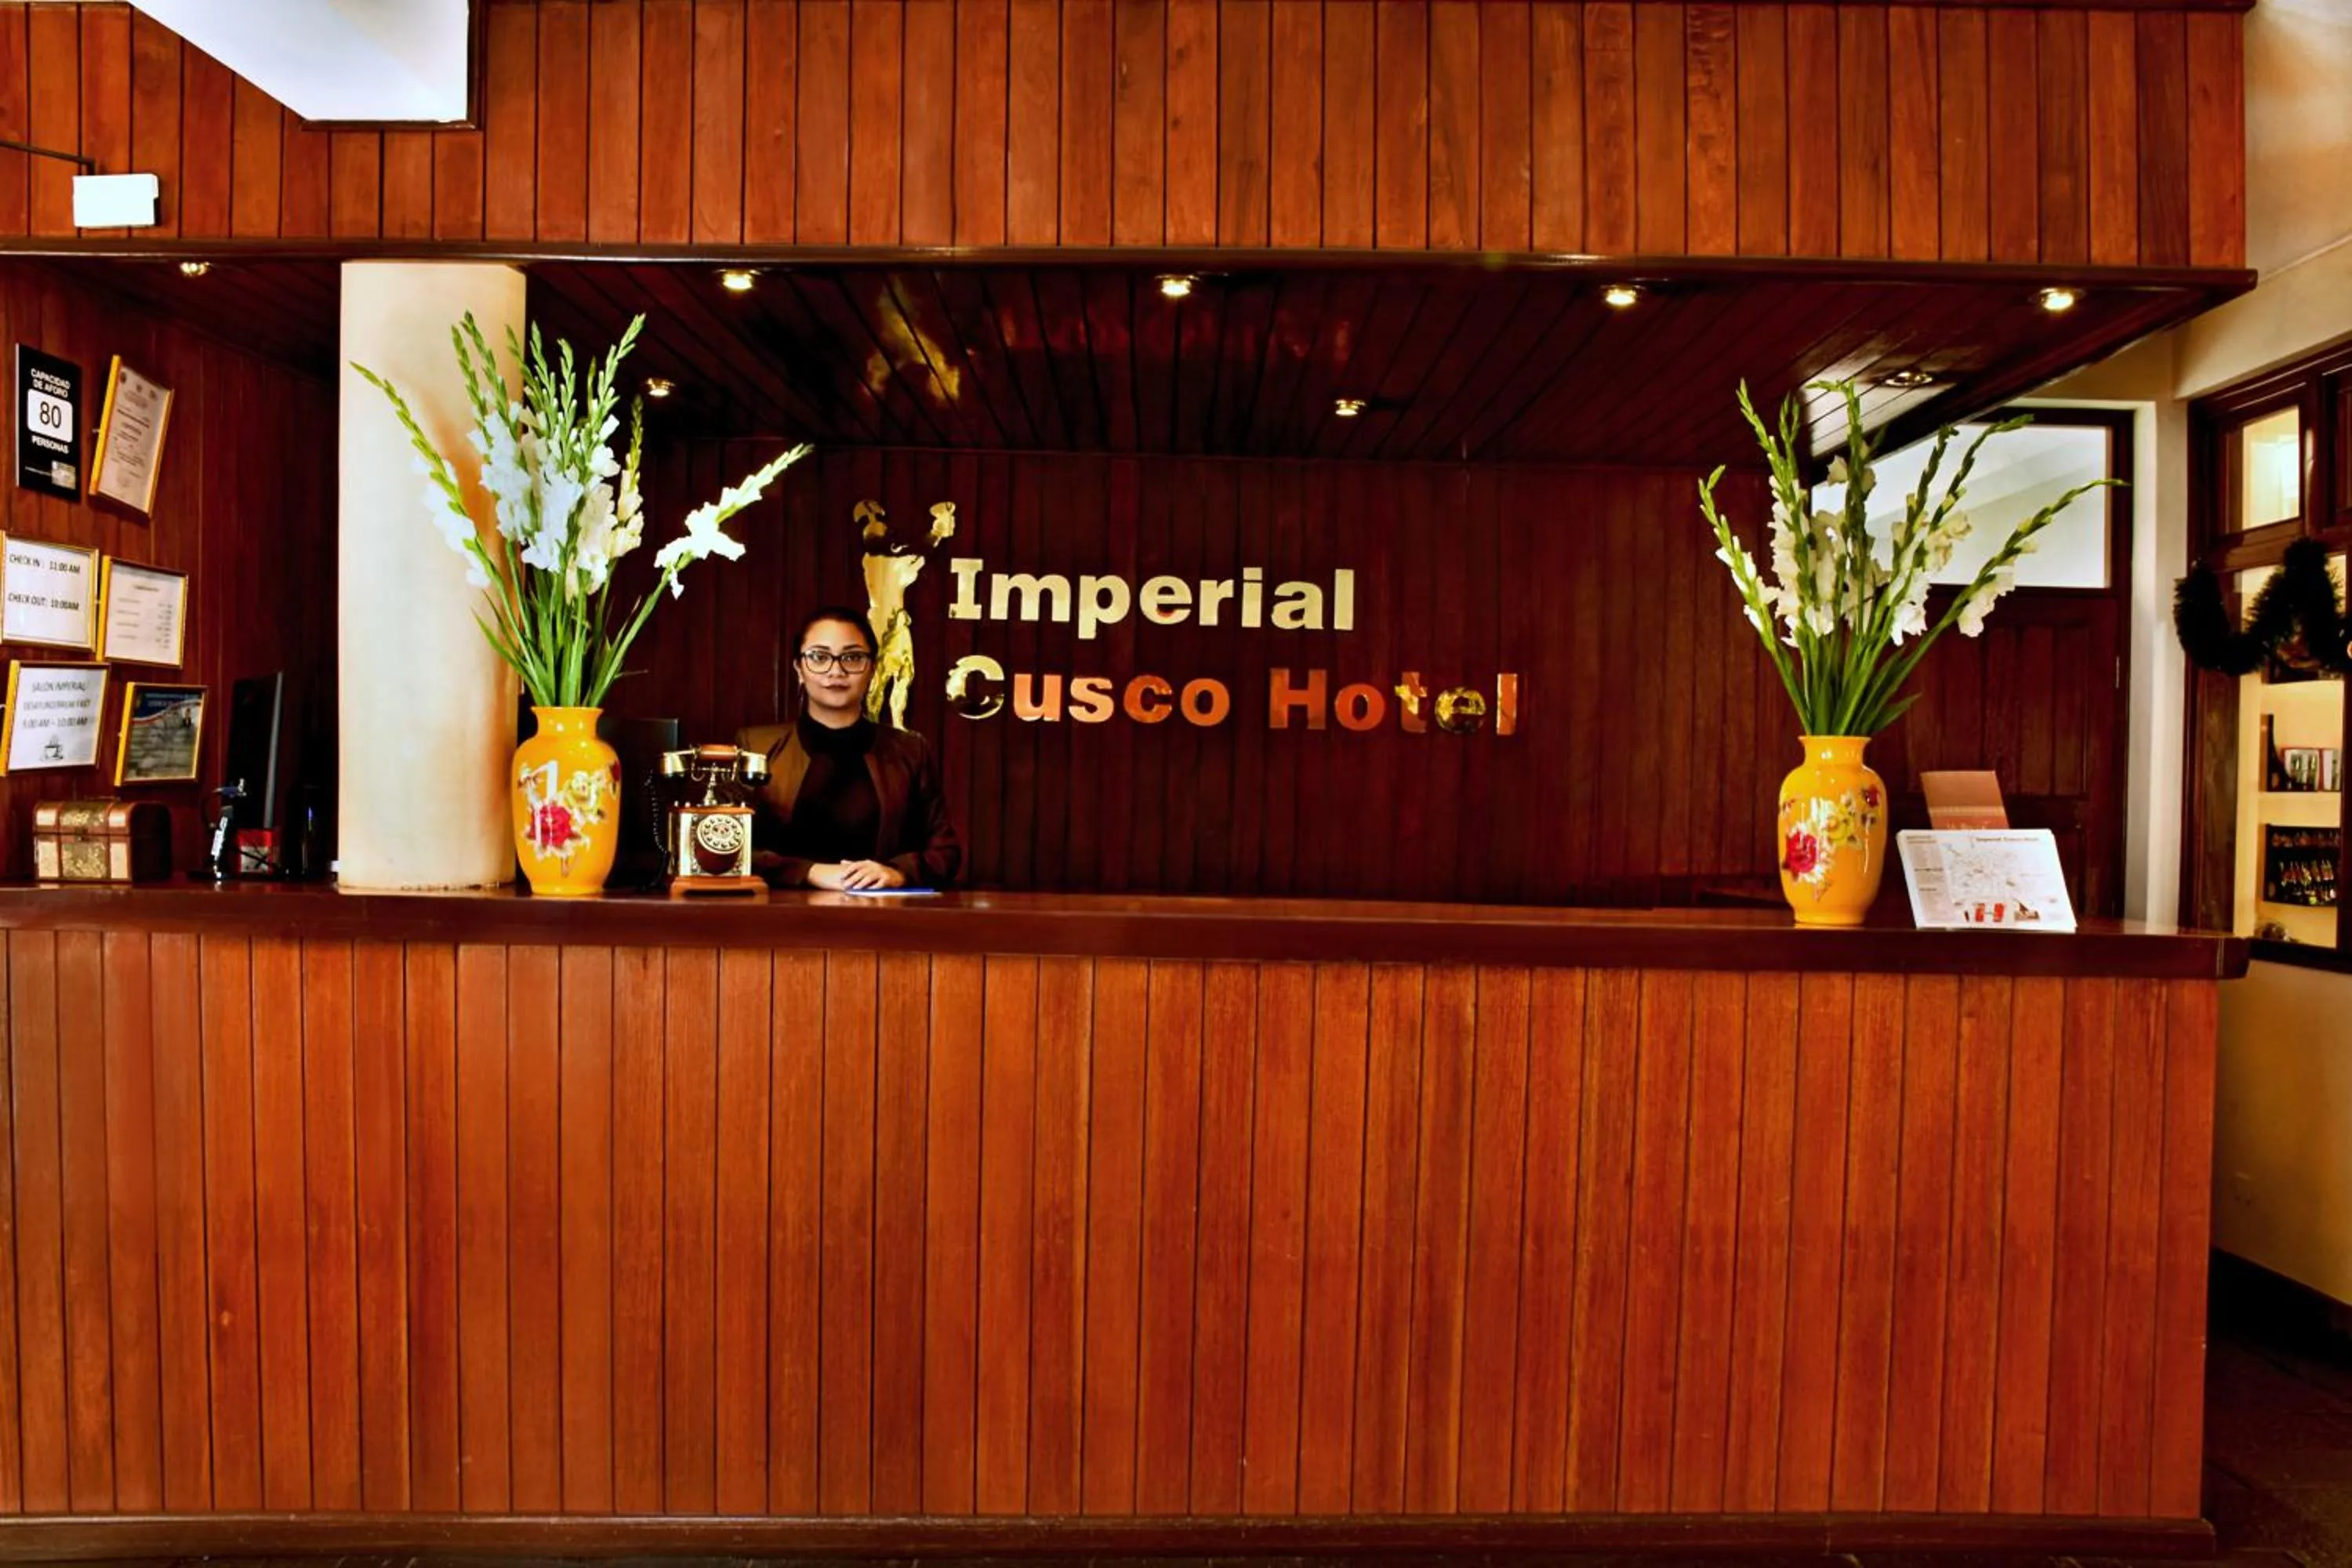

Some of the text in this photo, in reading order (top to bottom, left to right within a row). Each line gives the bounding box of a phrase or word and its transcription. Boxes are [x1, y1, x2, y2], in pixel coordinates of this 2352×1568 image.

[31, 368, 71, 390] CAPACIDAD
[33, 379, 68, 398] DE AFORO
[40, 401, 62, 428] 80
[31, 435, 69, 454] PERSONAS
[9, 554, 31, 565] CHECK
[8, 592, 30, 604] CHECK
[950, 557, 1356, 639] Imperial
[946, 654, 1518, 736] Cusco Hotel
